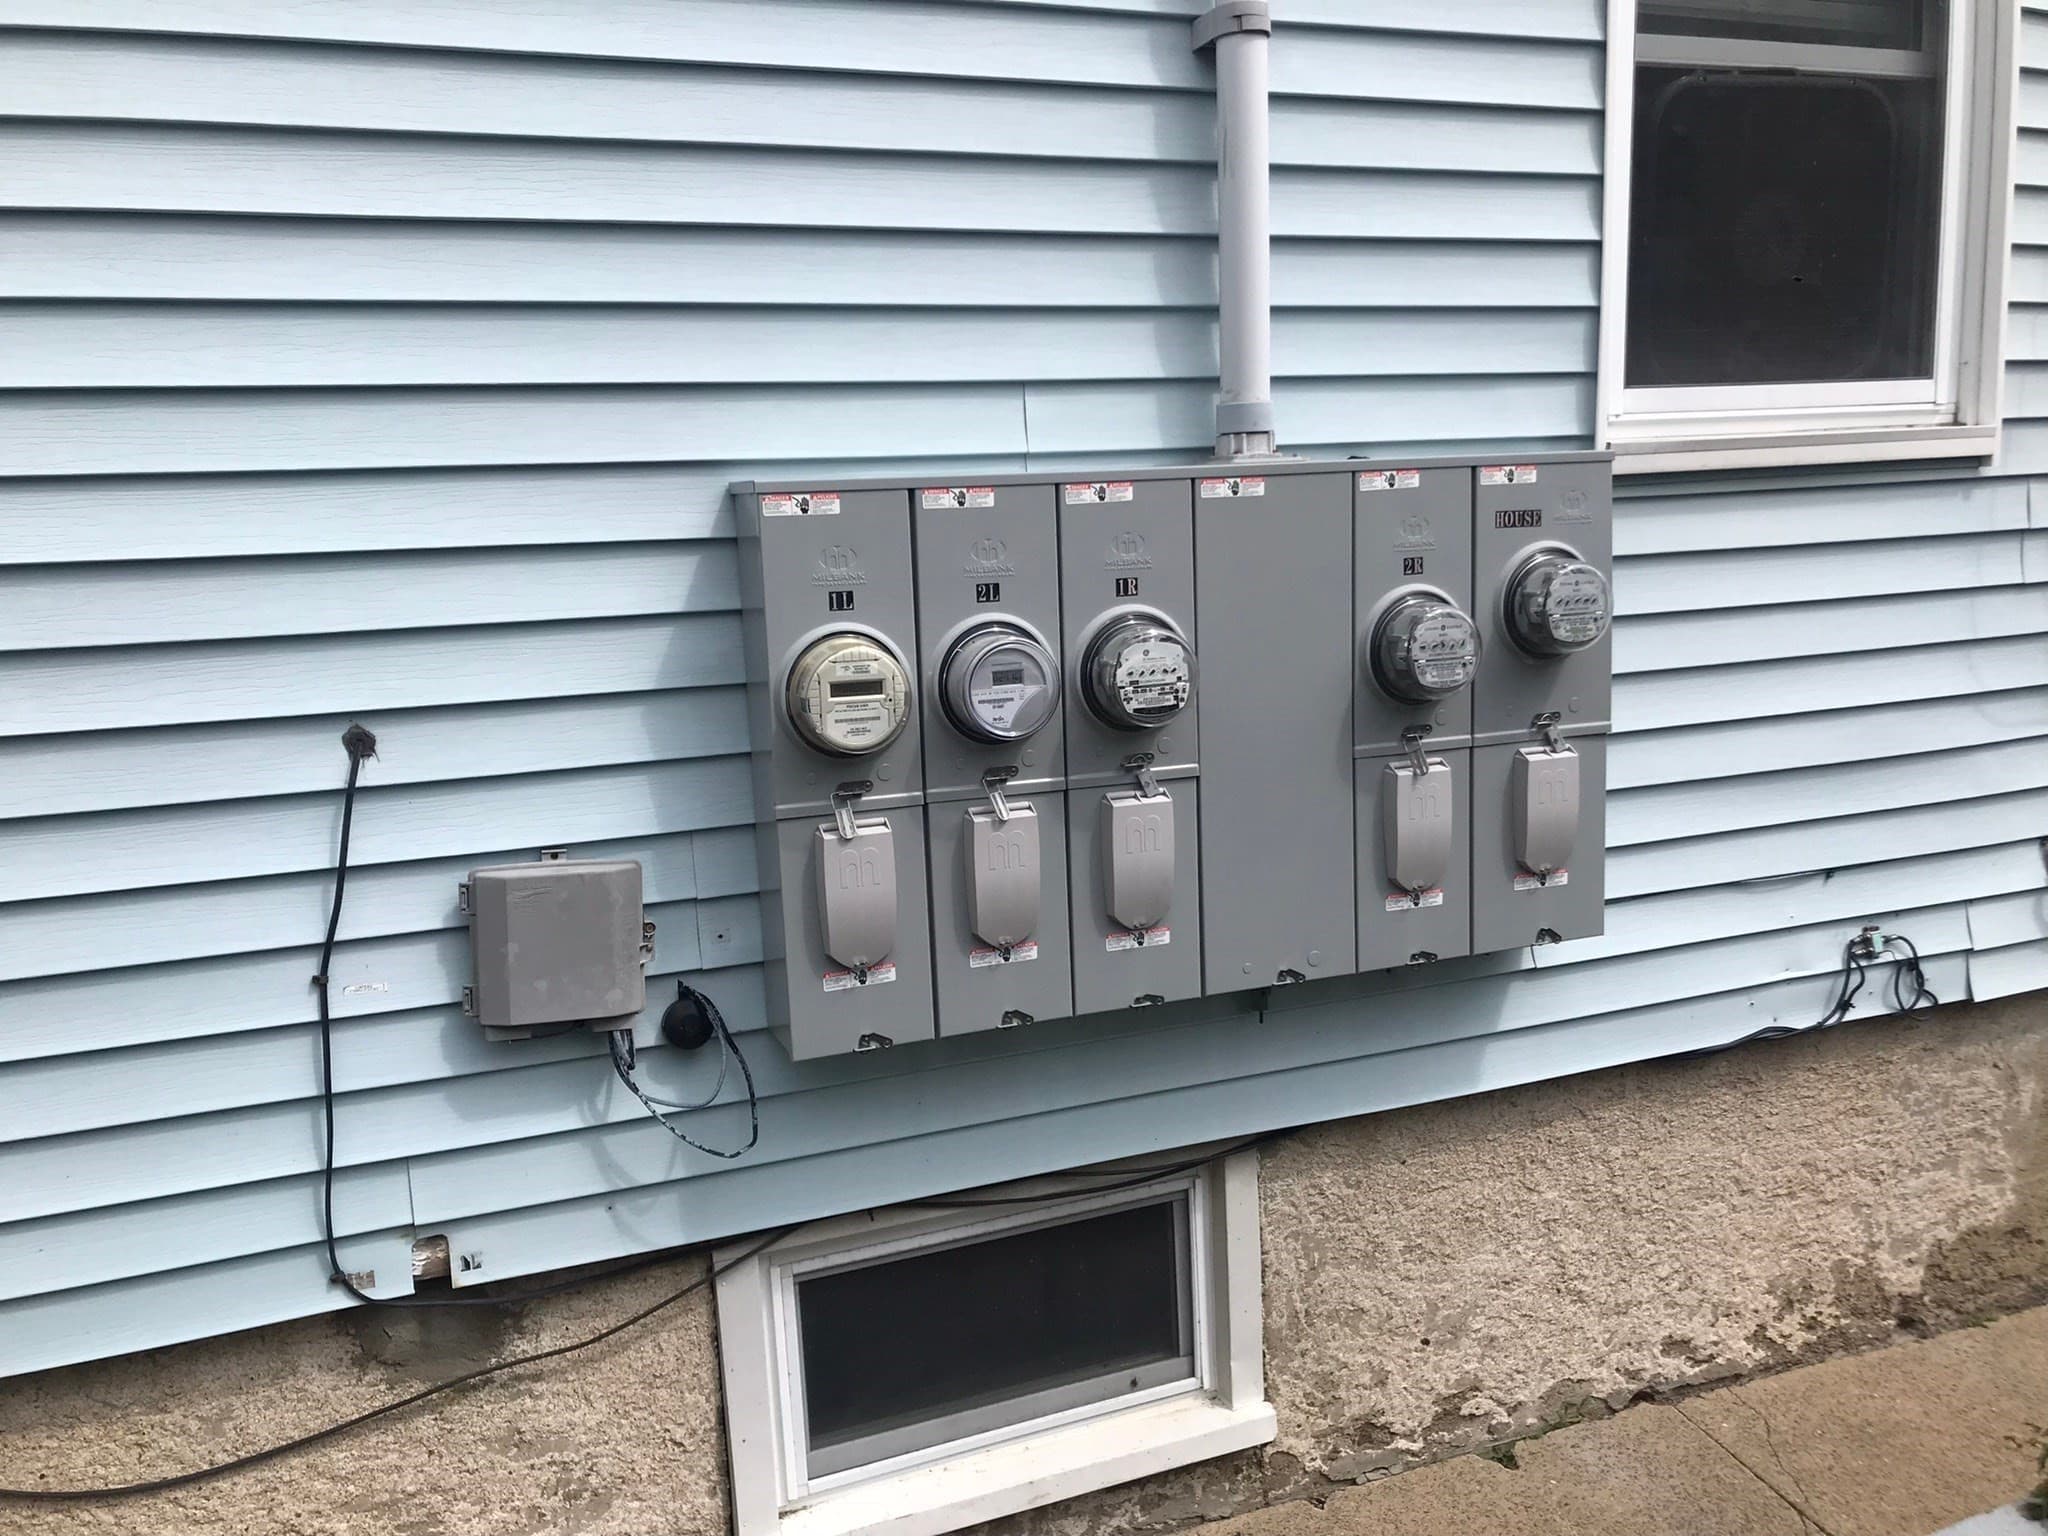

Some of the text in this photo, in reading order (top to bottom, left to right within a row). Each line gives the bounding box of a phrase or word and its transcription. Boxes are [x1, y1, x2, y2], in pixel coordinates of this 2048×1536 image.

[1495, 510, 1541, 528] HOUSE
[1405, 557, 1423, 575] 2R
[811, 571, 866, 583] MILBANK
[978, 583, 1000, 602] 2L
[1117, 578, 1138, 597] 1R
[830, 591, 854, 611] 1L
